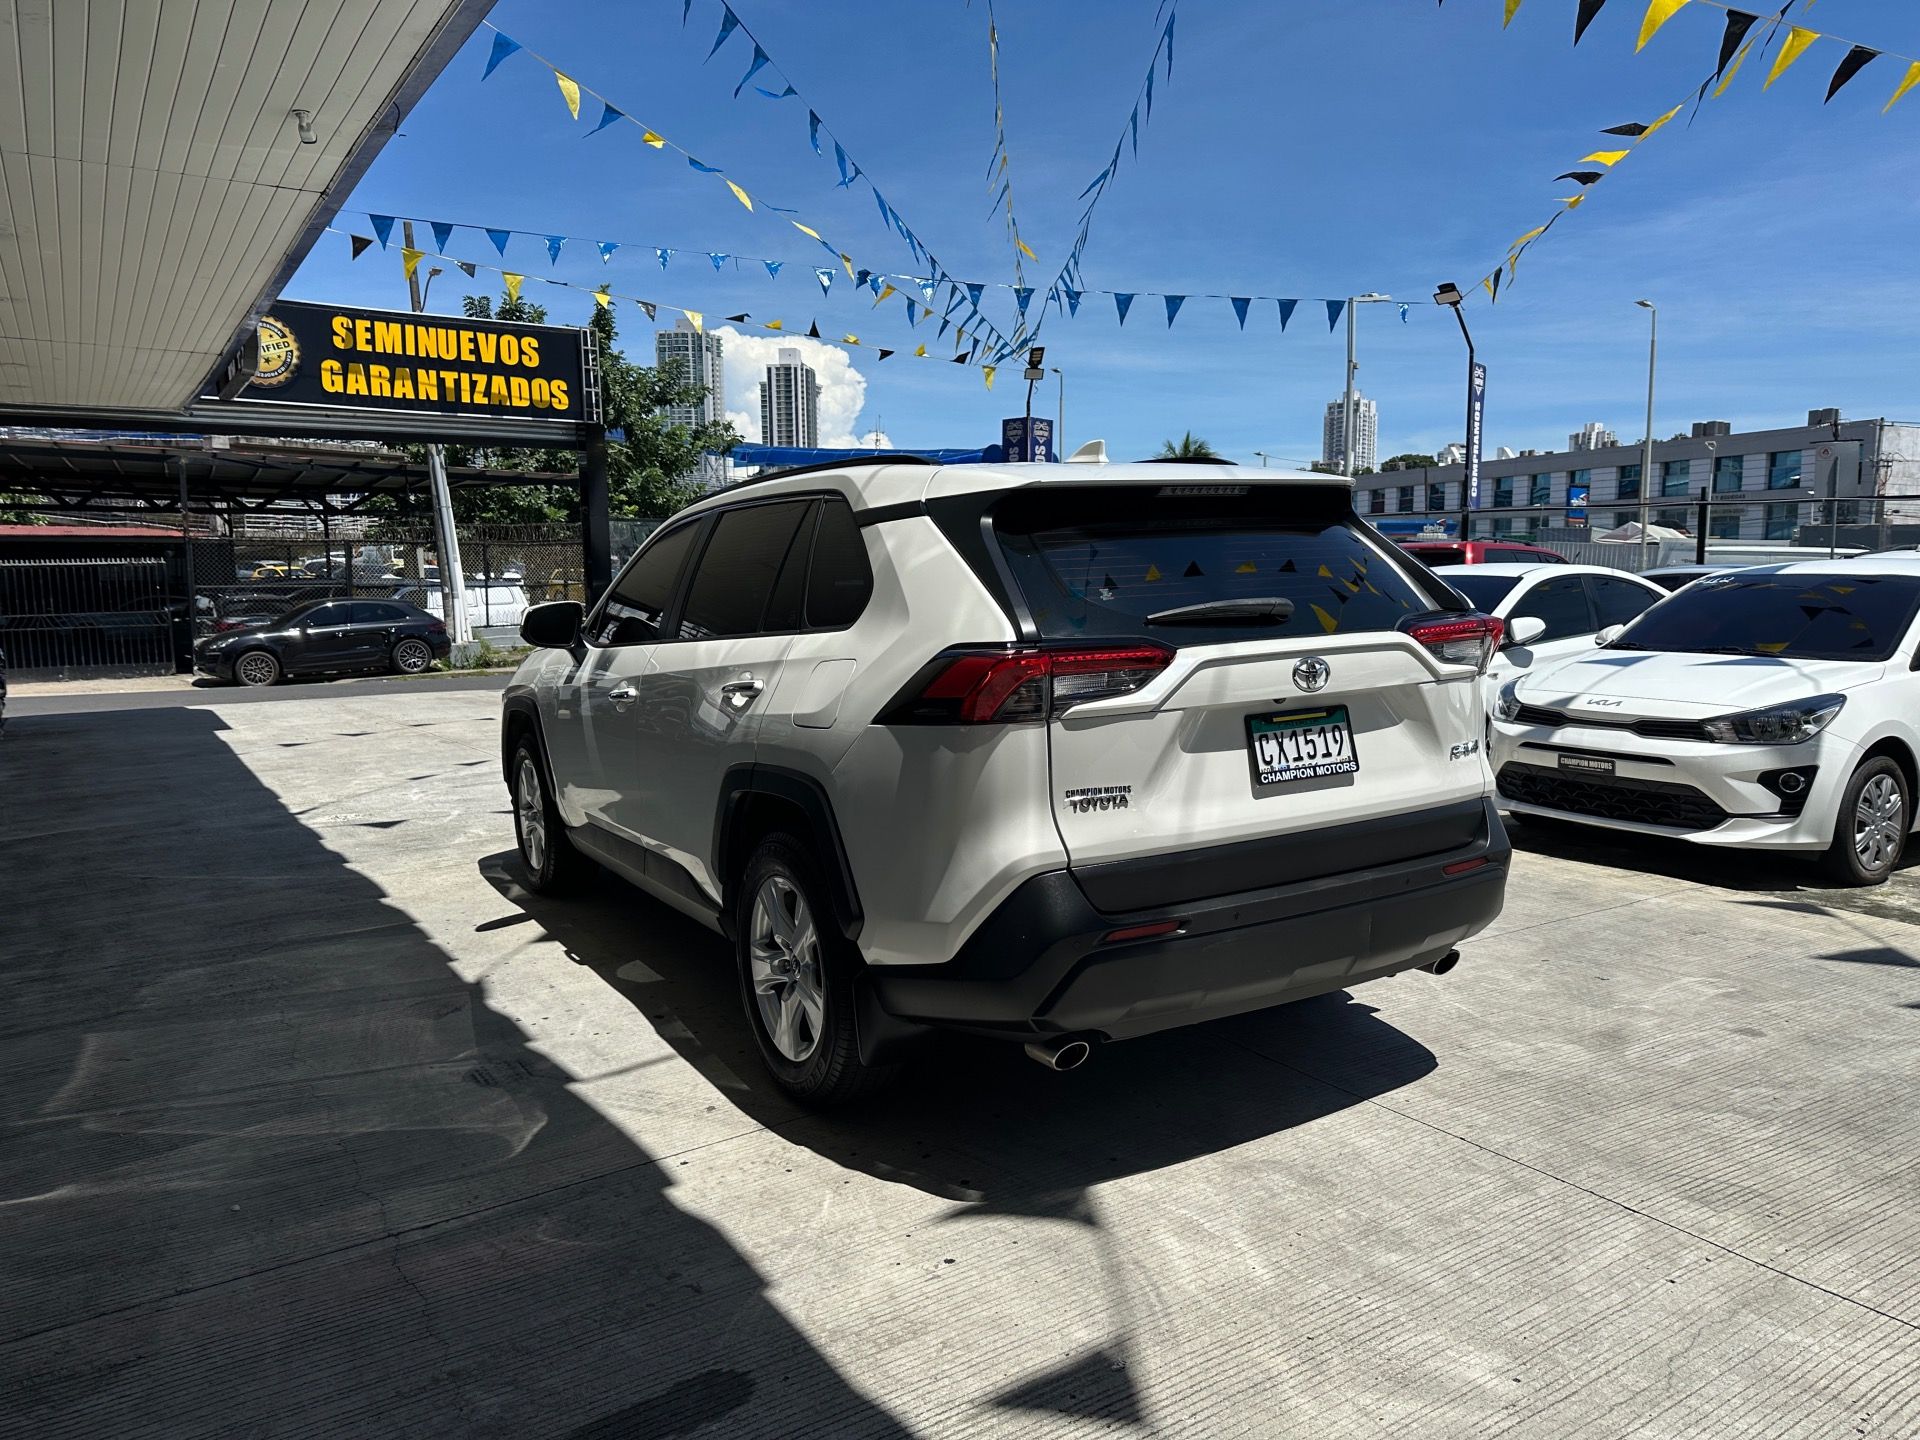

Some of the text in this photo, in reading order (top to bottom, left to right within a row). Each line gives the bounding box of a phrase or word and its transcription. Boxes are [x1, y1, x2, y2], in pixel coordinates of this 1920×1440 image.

[261, 341, 290, 353] IFIED
[331, 315, 540, 368] SEMINUEVOS
[320, 358, 569, 411] GARANTIZADOS
[1471, 401, 1481, 497] COMPRAMOS
[1258, 724, 1344, 766] CX1519
[1261, 767, 1314, 783] CHAMPION
[1316, 761, 1357, 776] MOTORS
[1560, 757, 1589, 767] CHAMPION
[1588, 760, 1613, 770] MOTORS
[1065, 785, 1132, 798] CHAMPION MOTORS
[1068, 795, 1129, 814] TOYOTA
